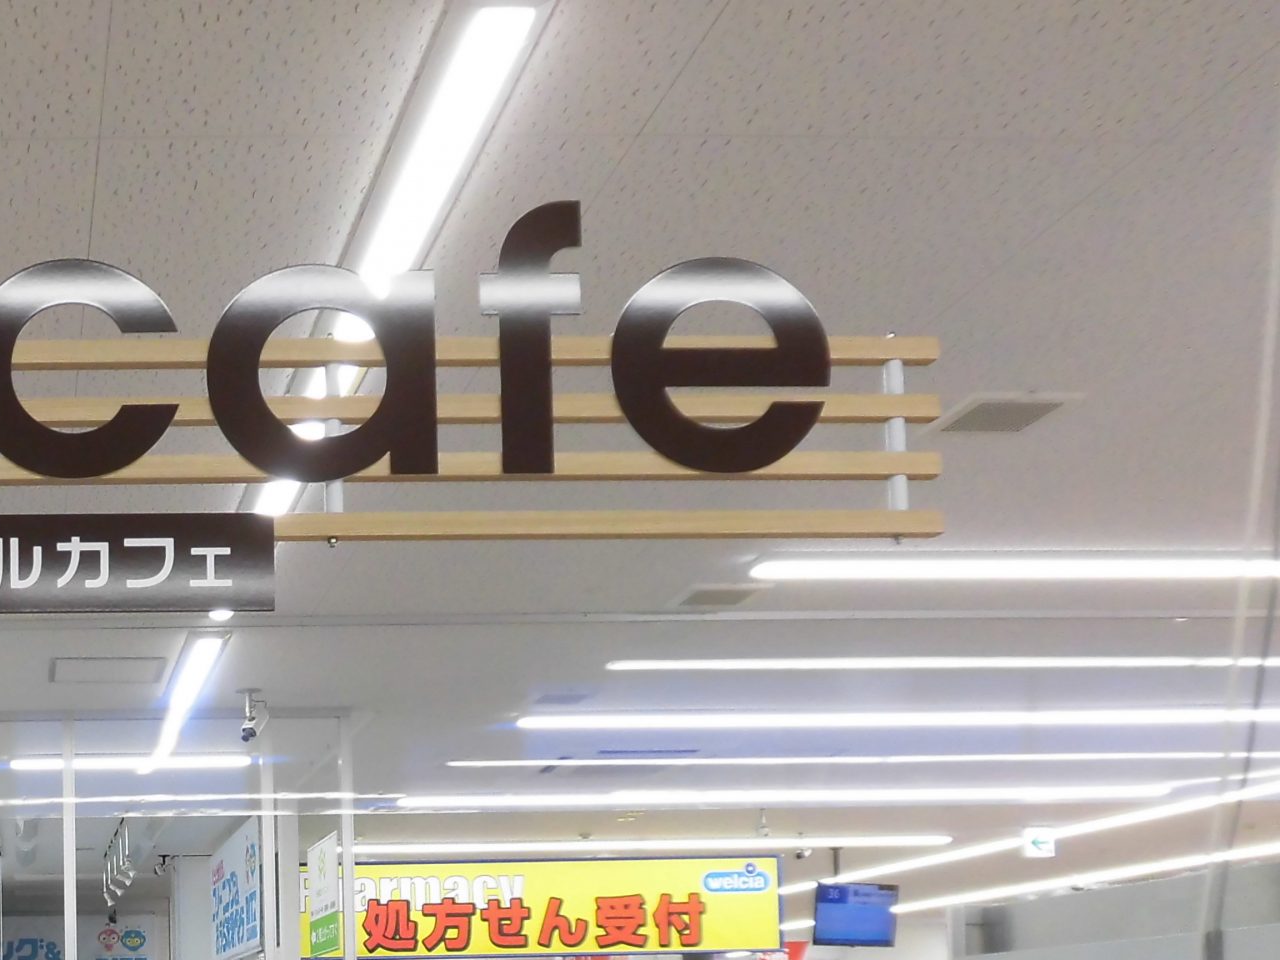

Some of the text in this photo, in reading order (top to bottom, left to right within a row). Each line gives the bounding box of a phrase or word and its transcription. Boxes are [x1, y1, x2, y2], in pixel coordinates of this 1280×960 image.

[706, 872, 765, 890] welcia
[363, 893, 706, 952] 処方せん受付
